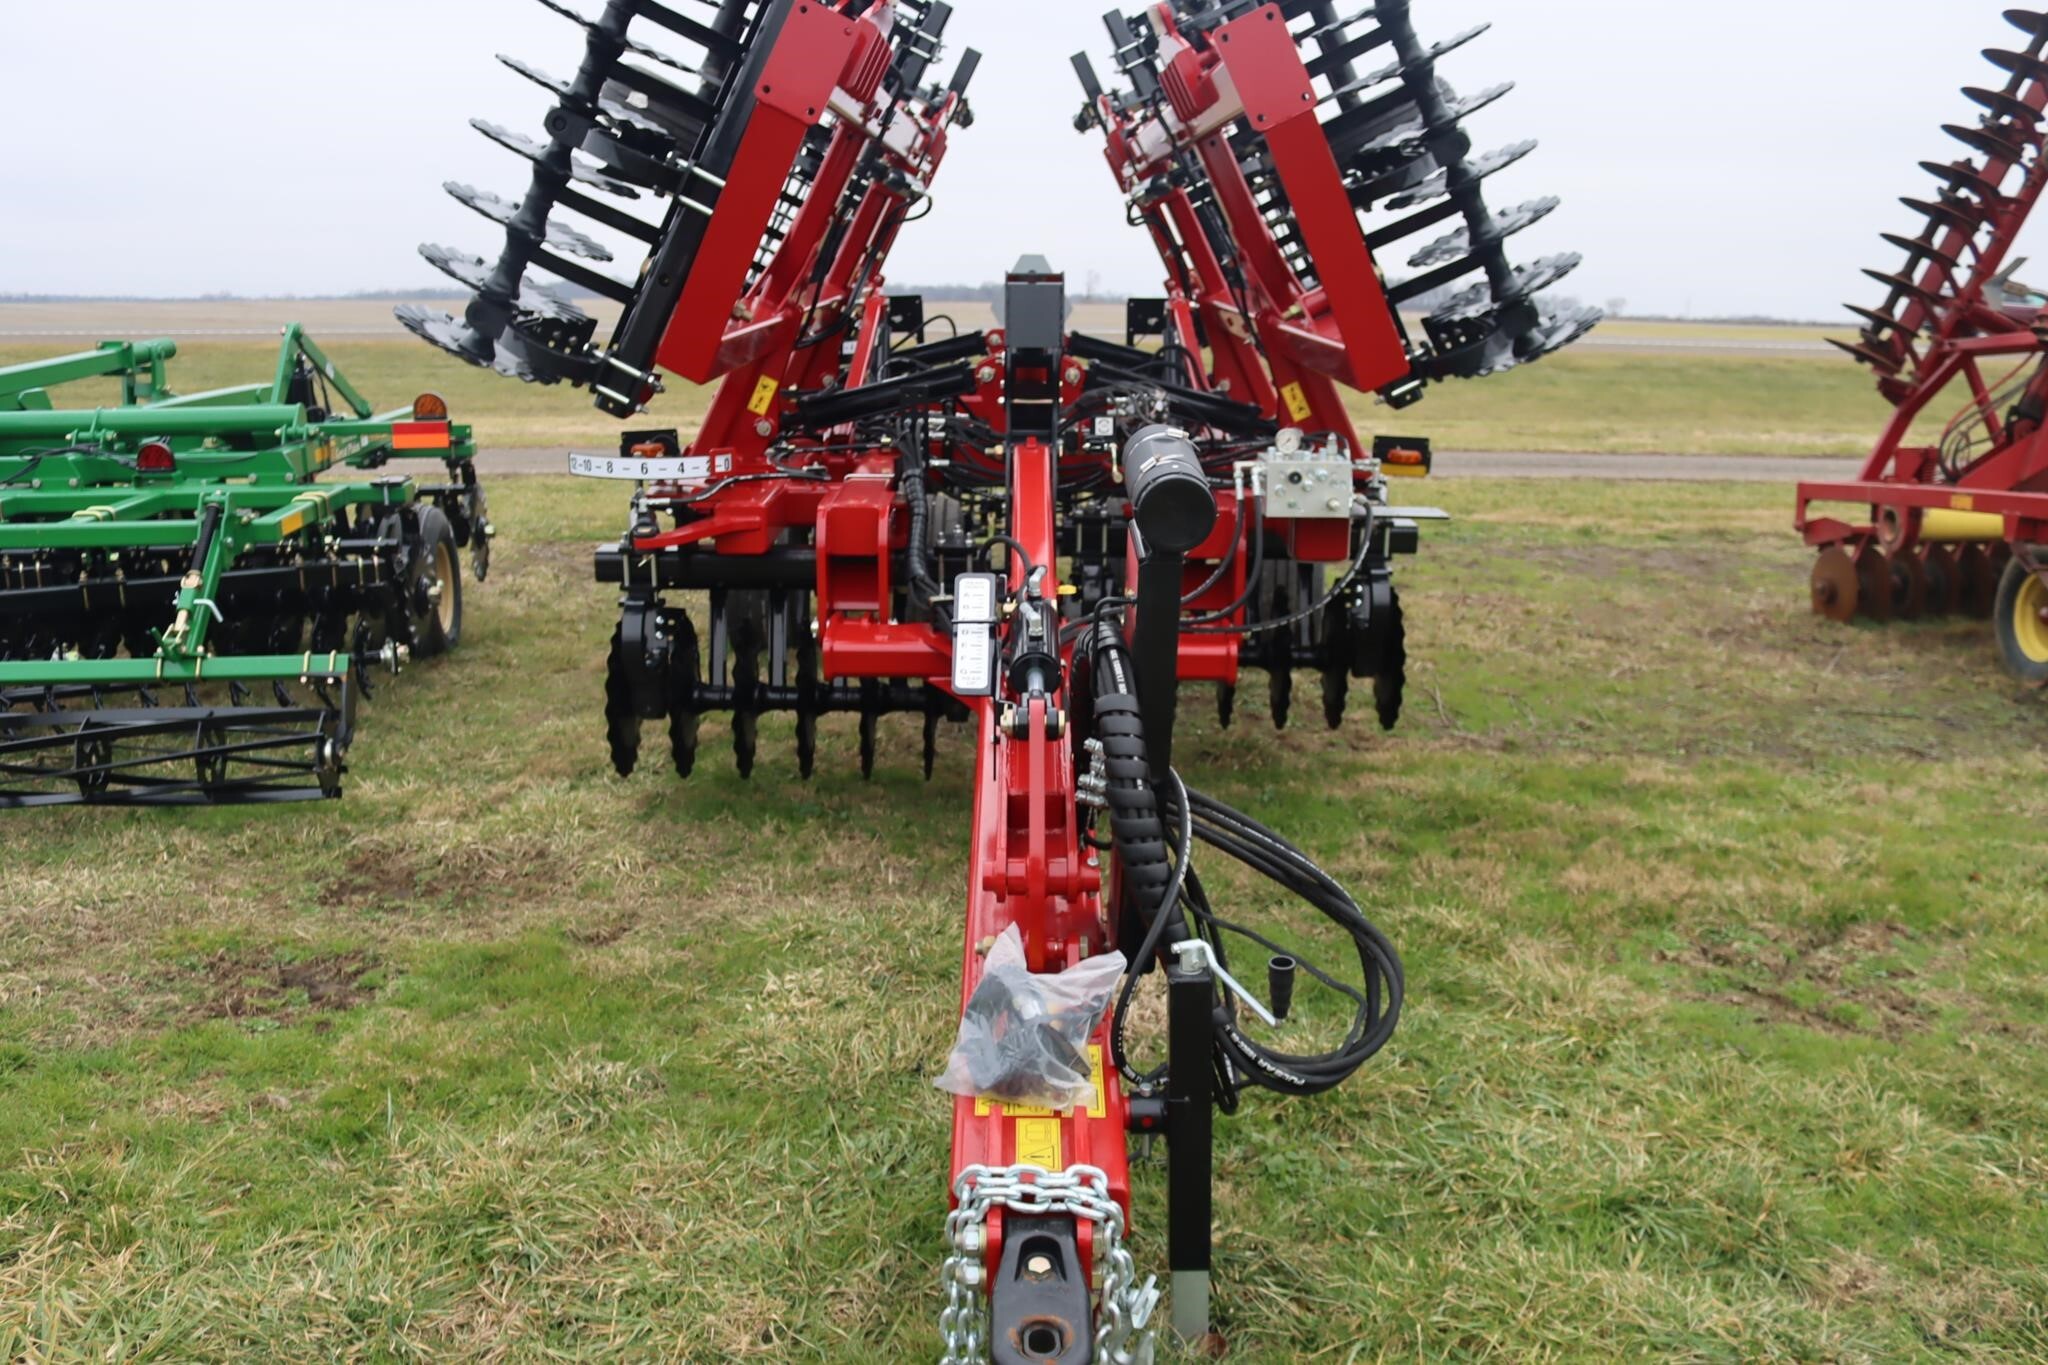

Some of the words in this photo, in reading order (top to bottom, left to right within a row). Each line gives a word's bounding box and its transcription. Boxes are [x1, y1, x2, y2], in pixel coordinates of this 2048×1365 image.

[606, 460, 614, 474] 8
[641, 462, 649, 475] 6
[677, 461, 685, 474] 4
